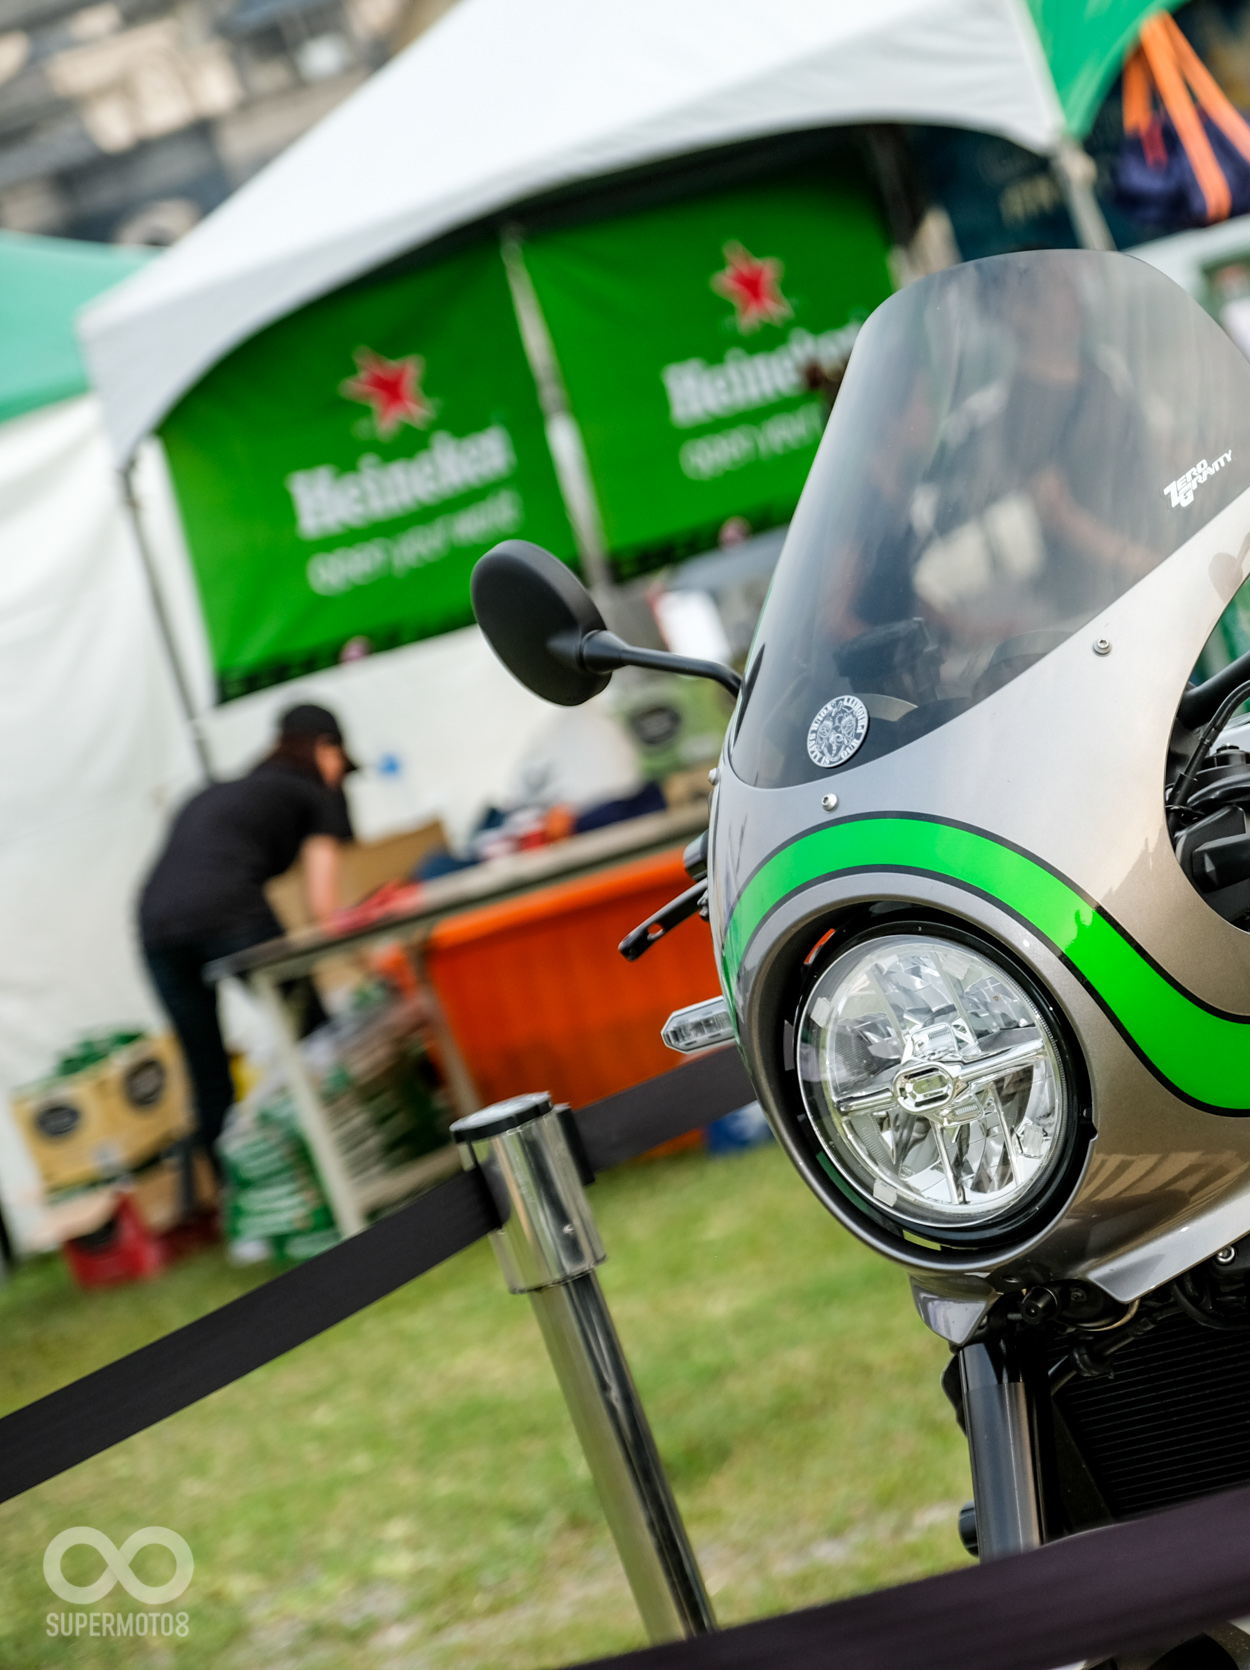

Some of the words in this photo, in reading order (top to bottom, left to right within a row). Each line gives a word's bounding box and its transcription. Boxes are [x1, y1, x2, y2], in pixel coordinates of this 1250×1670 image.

[286, 425, 516, 541] Heineken
[1163, 459, 1208, 508] ZERO
[1179, 449, 1232, 508] GRAVITY
